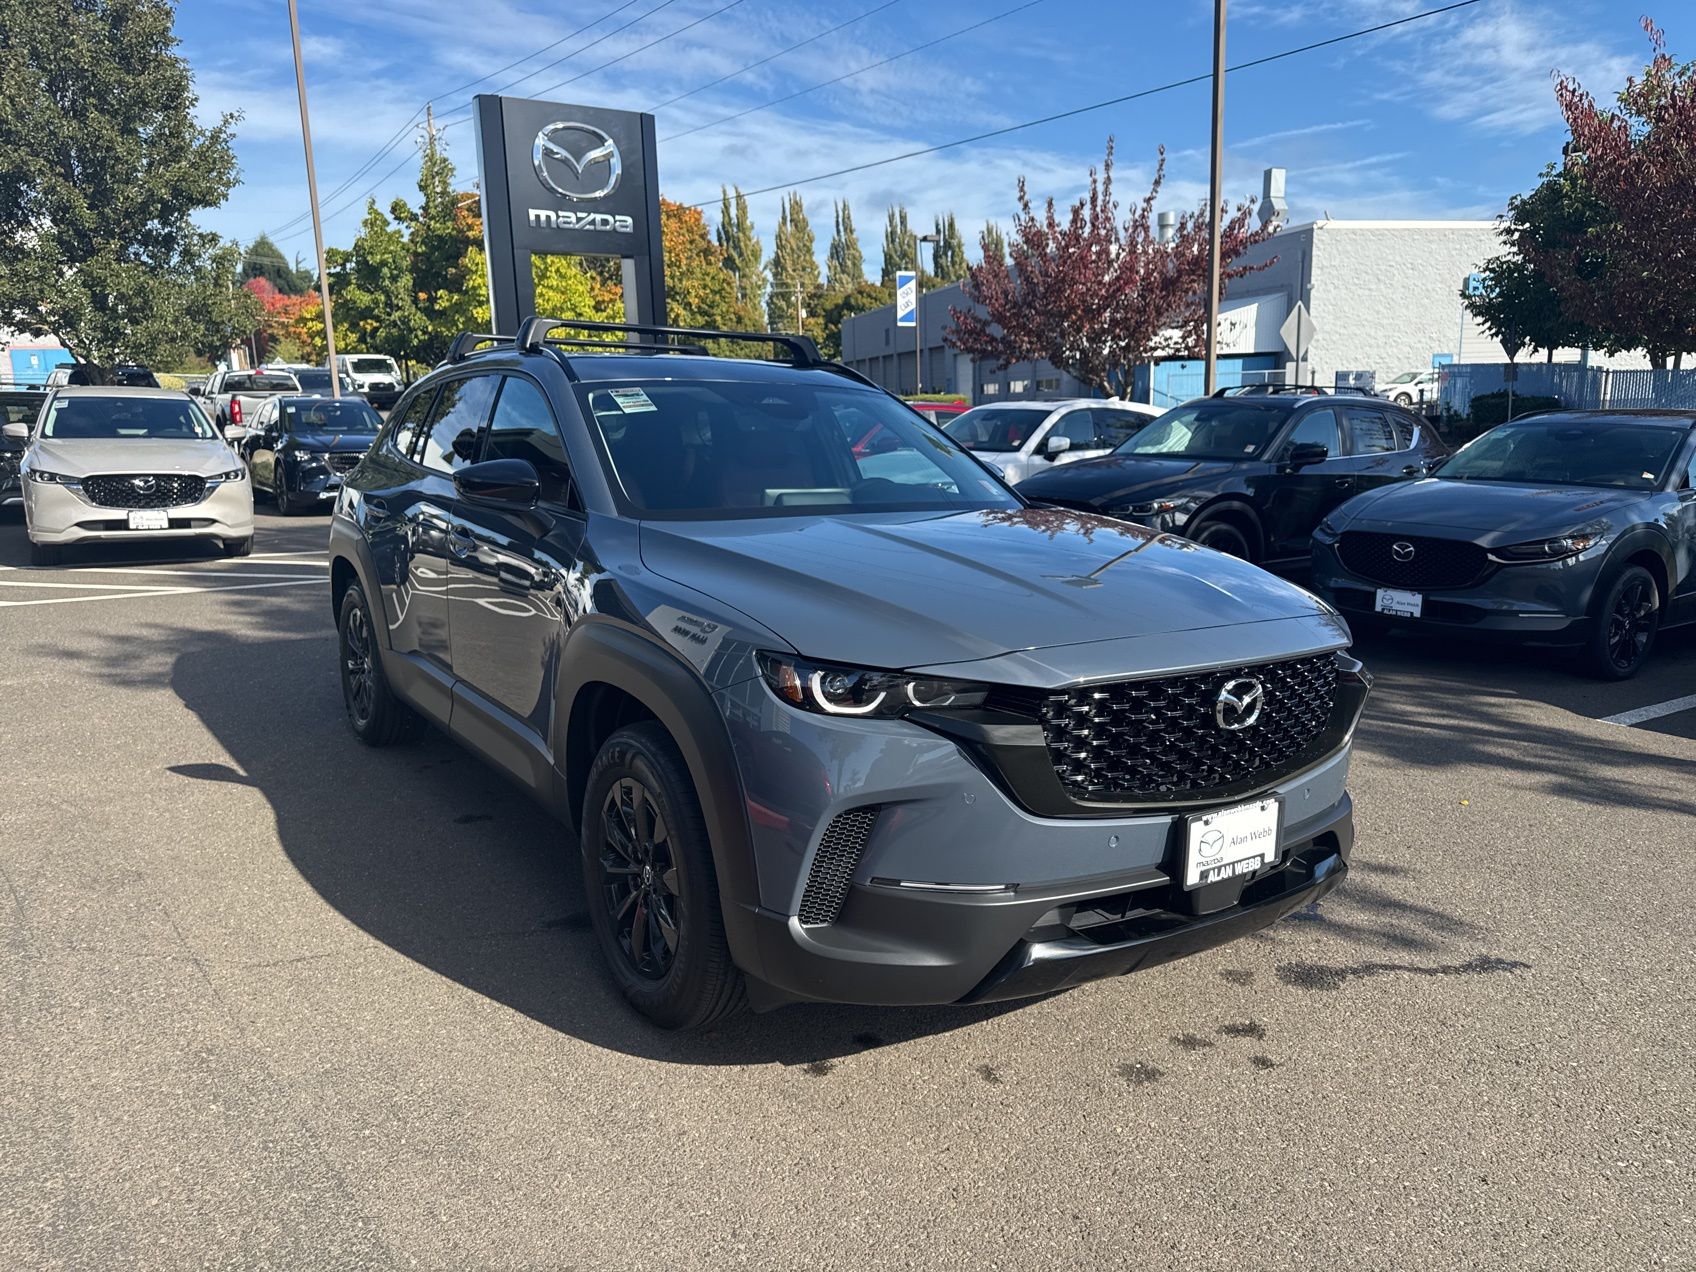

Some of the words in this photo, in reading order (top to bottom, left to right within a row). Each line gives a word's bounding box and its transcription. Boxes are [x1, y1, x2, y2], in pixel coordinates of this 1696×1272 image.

[1229, 834, 1248, 848] Alan
[1249, 826, 1273, 842] Webb
[1207, 866, 1233, 883] ALAN
[1234, 856, 1261, 875] WEBB
